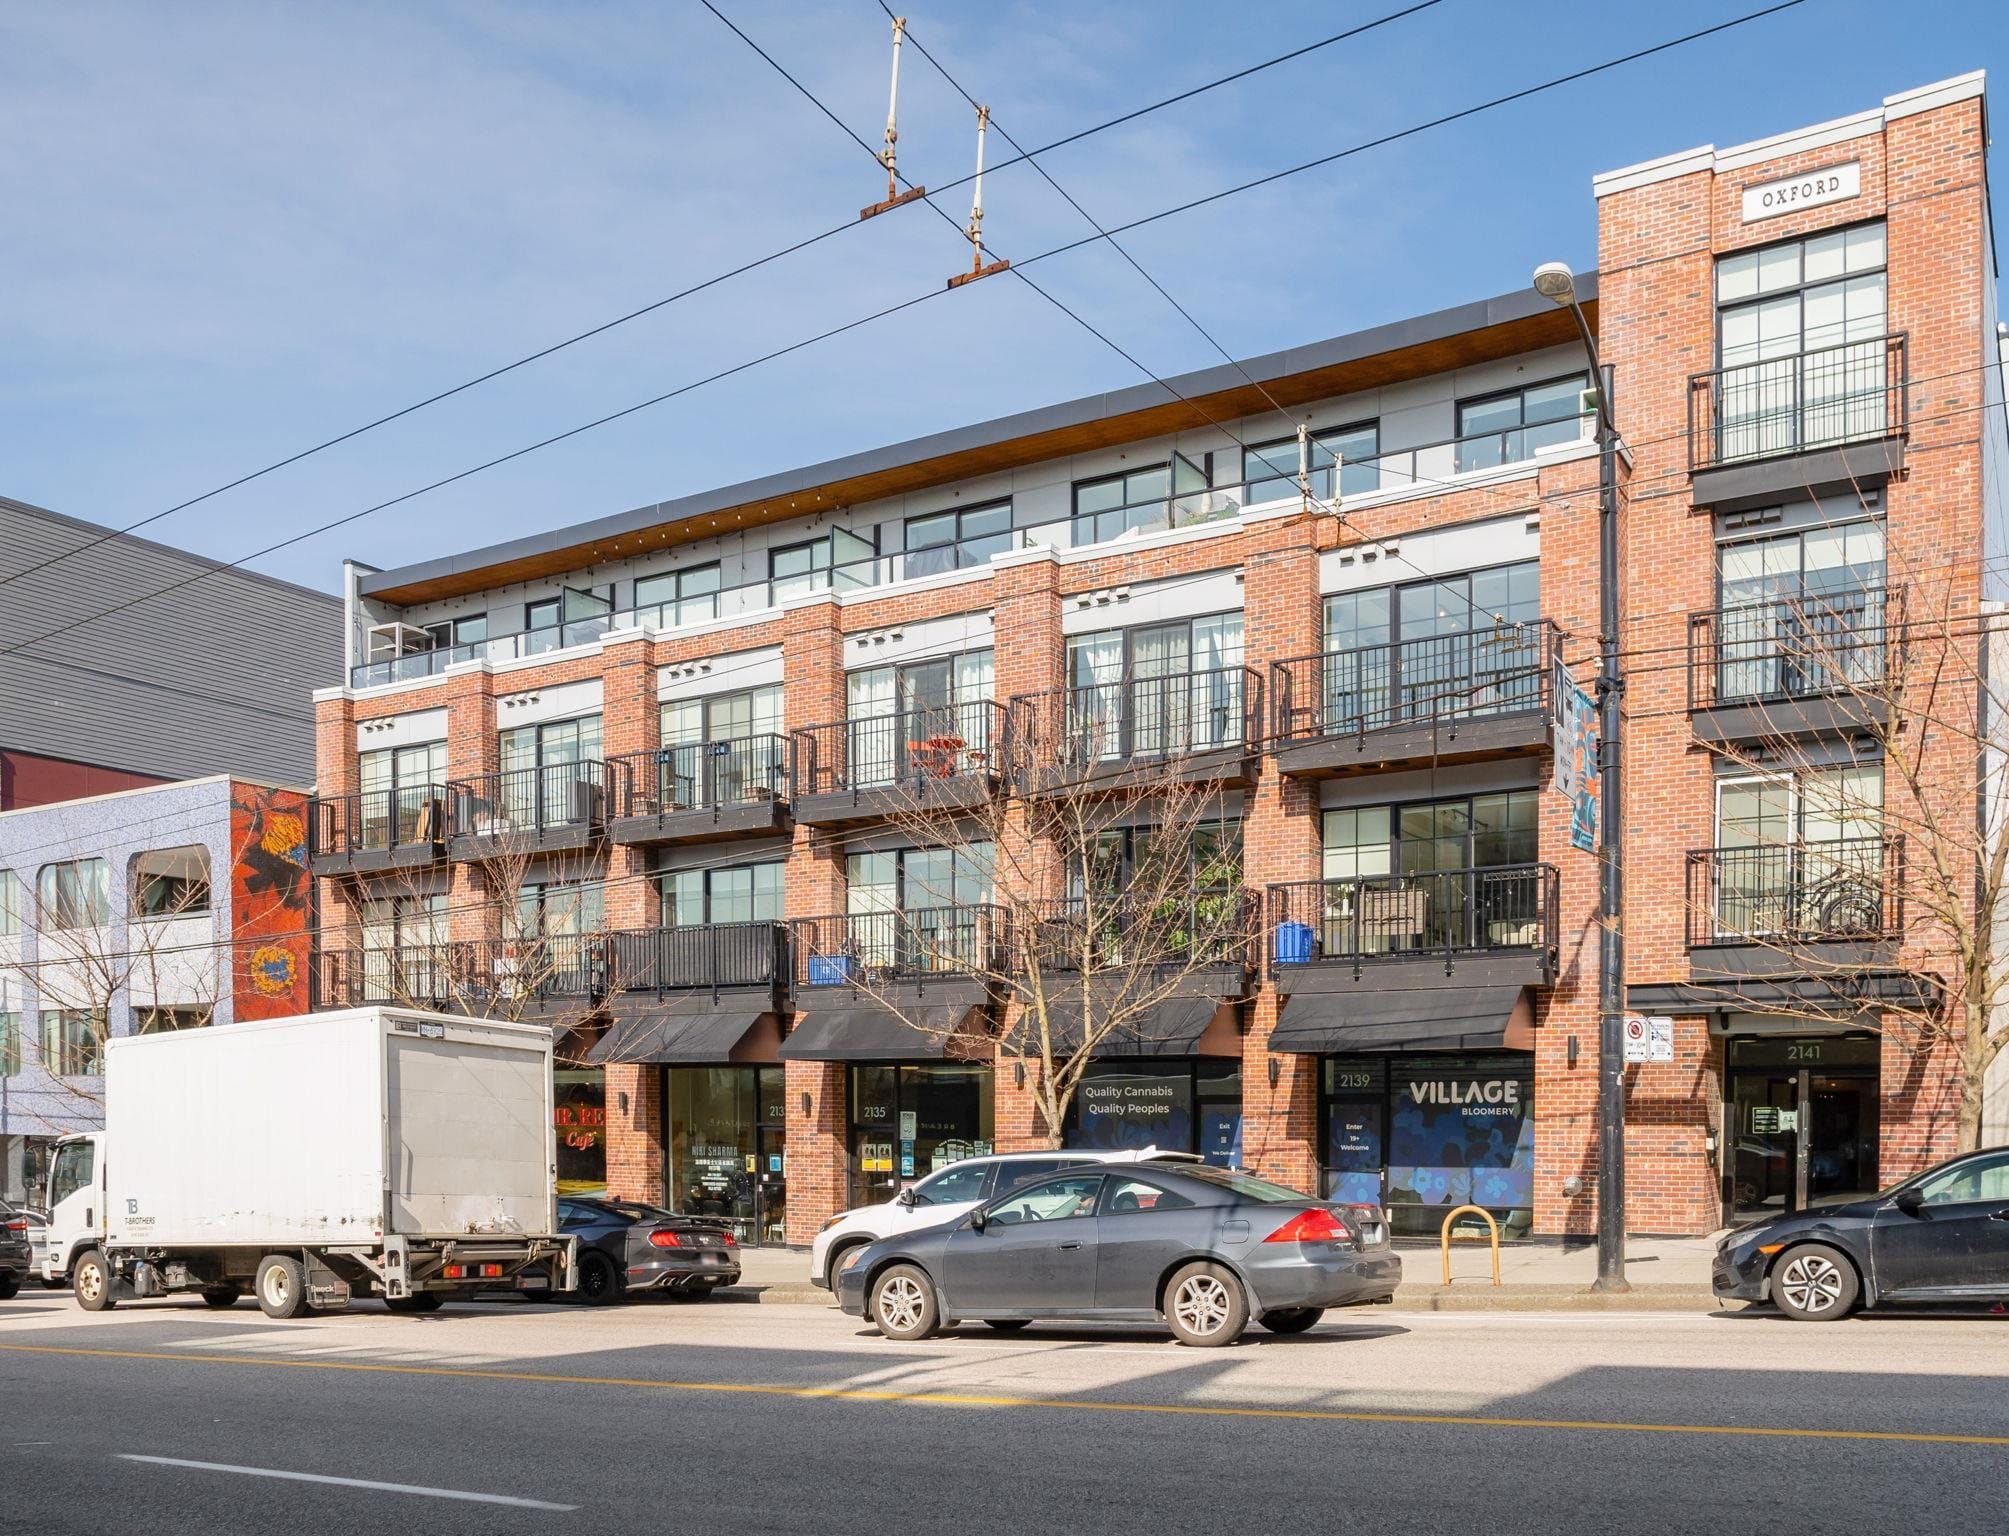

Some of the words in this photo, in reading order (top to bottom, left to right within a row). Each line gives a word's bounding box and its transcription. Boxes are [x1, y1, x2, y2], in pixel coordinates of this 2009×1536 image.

[1762, 177, 1840, 207] OXFORD
[1787, 1046, 1820, 1060] 2141
[1340, 1074, 1370, 1087] 2139
[1085, 1086, 1123, 1098] Quality
[1124, 1086, 1173, 1097] Cannabis
[1409, 1080, 1519, 1104] VILLAGE
[769, 1105, 785, 1117] 213
[864, 1106, 886, 1118] 2135
[1089, 1104, 1126, 1115] Quality
[1128, 1104, 1170, 1115] Peoples
[1461, 1107, 1515, 1116] BLOOMERY
[579, 1107, 606, 1126] RE
[708, 1145, 738, 1157] SHARMA
[124, 1217, 155, 1225] T-BROTHERS
